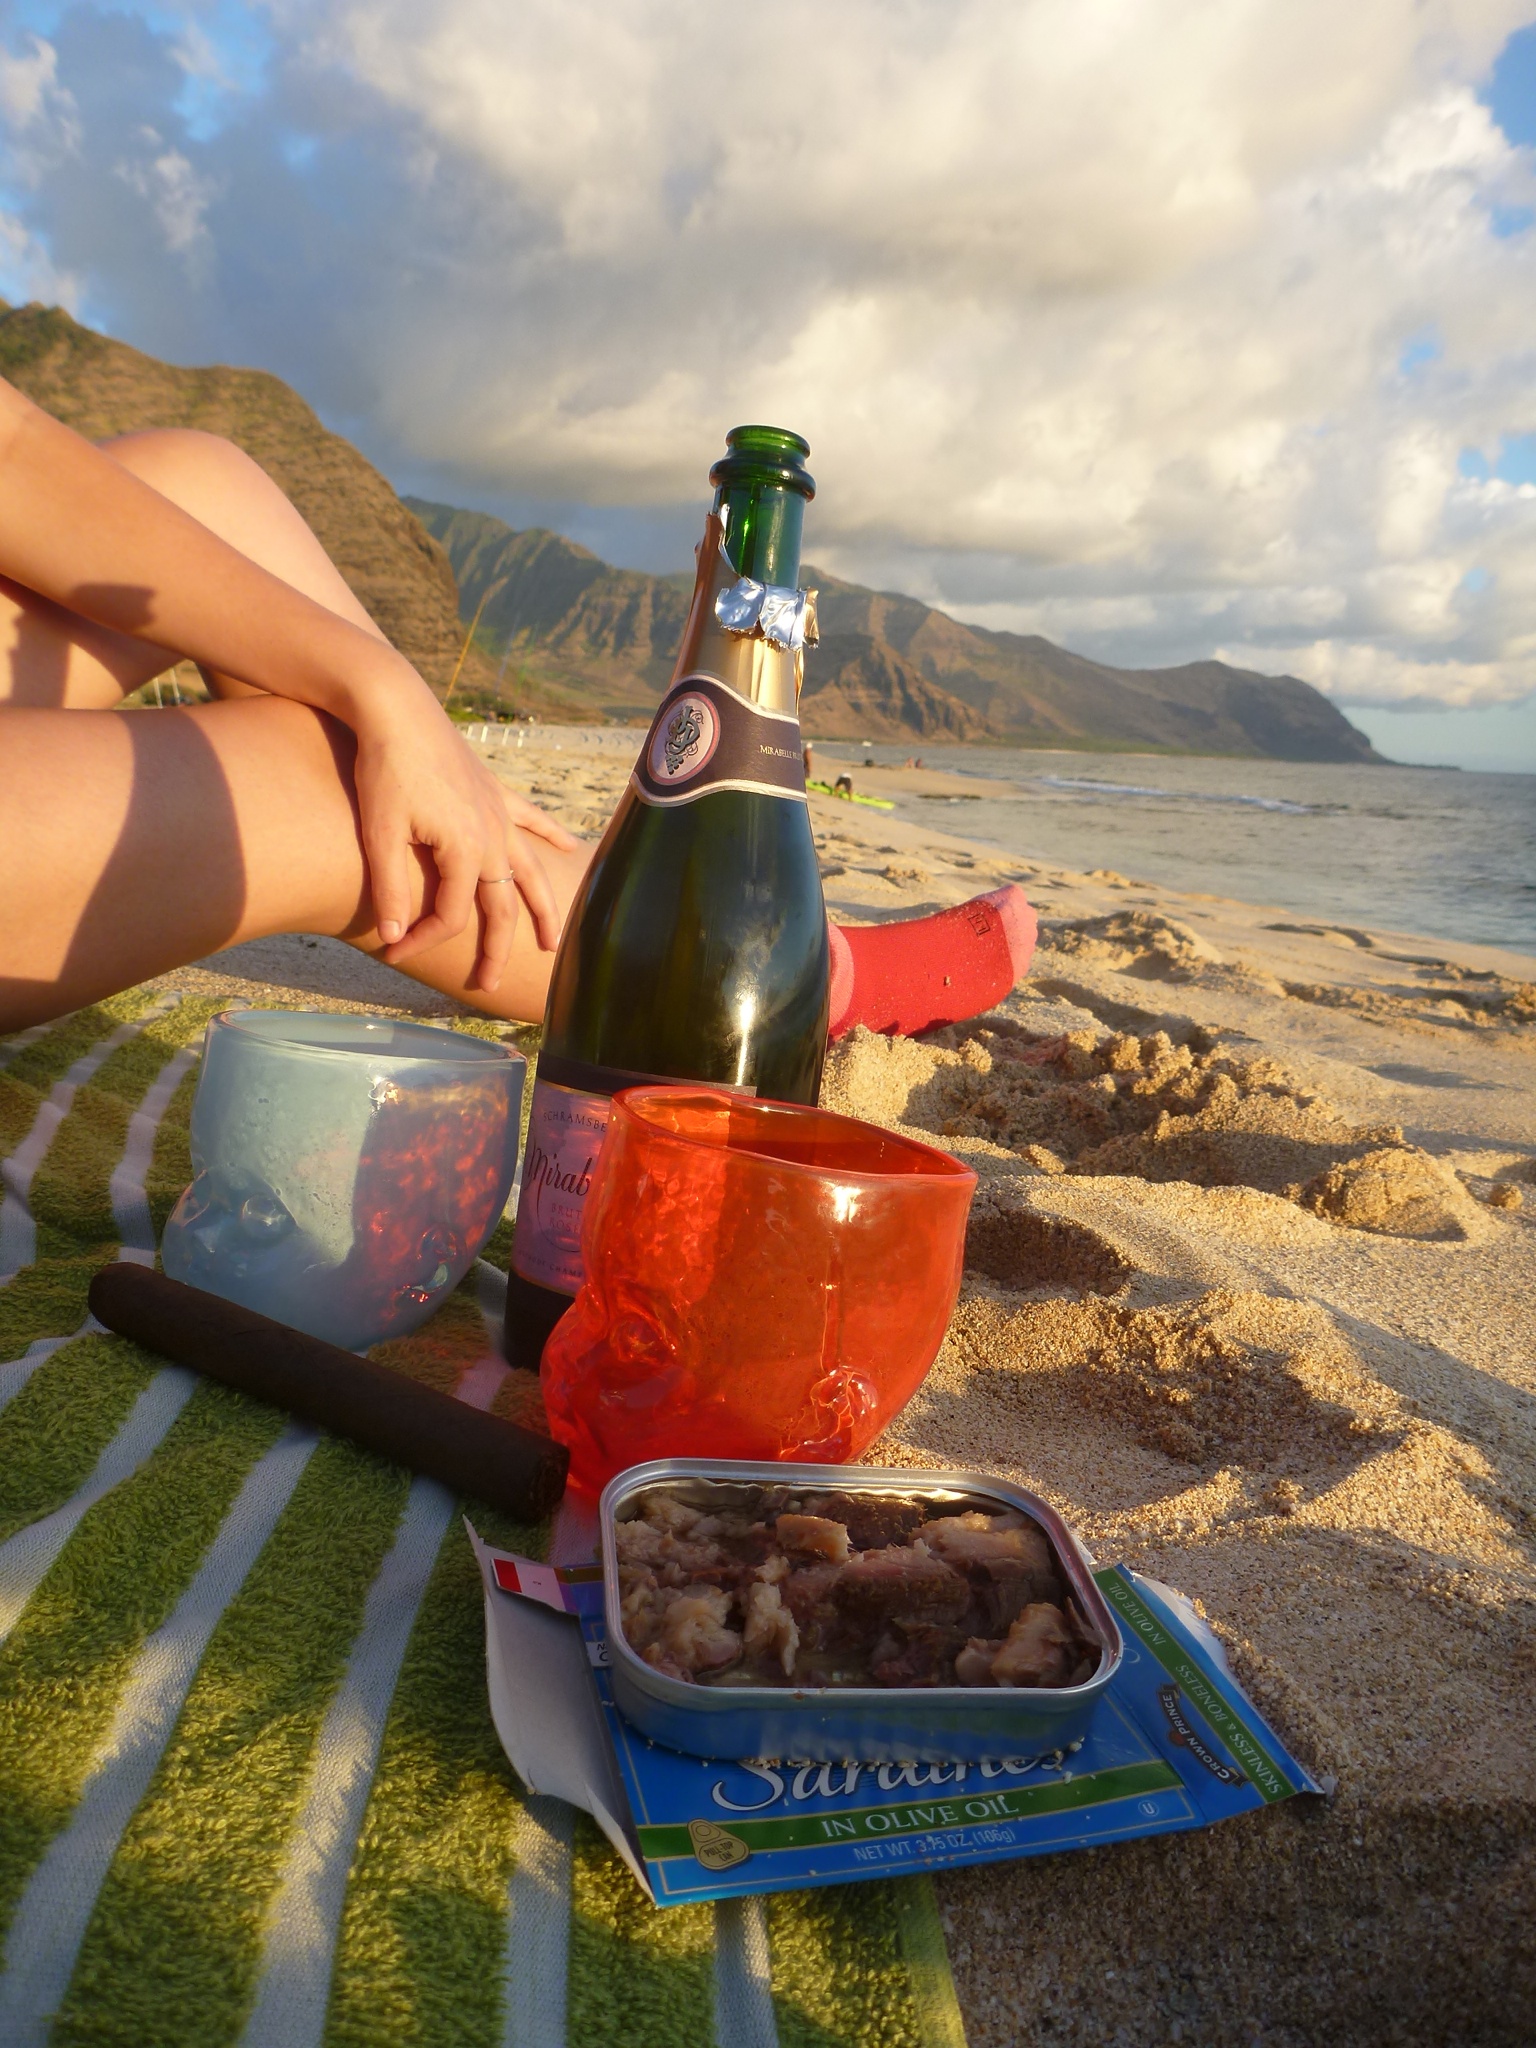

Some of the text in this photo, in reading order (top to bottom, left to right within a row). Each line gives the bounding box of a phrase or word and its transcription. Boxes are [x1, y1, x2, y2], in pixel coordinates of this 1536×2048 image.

[760, 744, 792, 758] MIRABELLE
[551, 1203, 582, 1220] BRUT
[1108, 1581, 1128, 1602] OIL
[1122, 1600, 1154, 1633] OLIVE
[1149, 1629, 1166, 1647] IN
[1161, 1693, 1232, 1780] CROWN PRINCE
[1175, 1664, 1284, 1795] SKINLESS & BONELESS
[821, 1794, 1019, 1839] IN OLIVE OIL
[719, 1851, 735, 1862] CAN
[852, 1843, 882, 1862] NET
[886, 1840, 915, 1858] WT.
[972, 1827, 1016, 1847] (106g)
